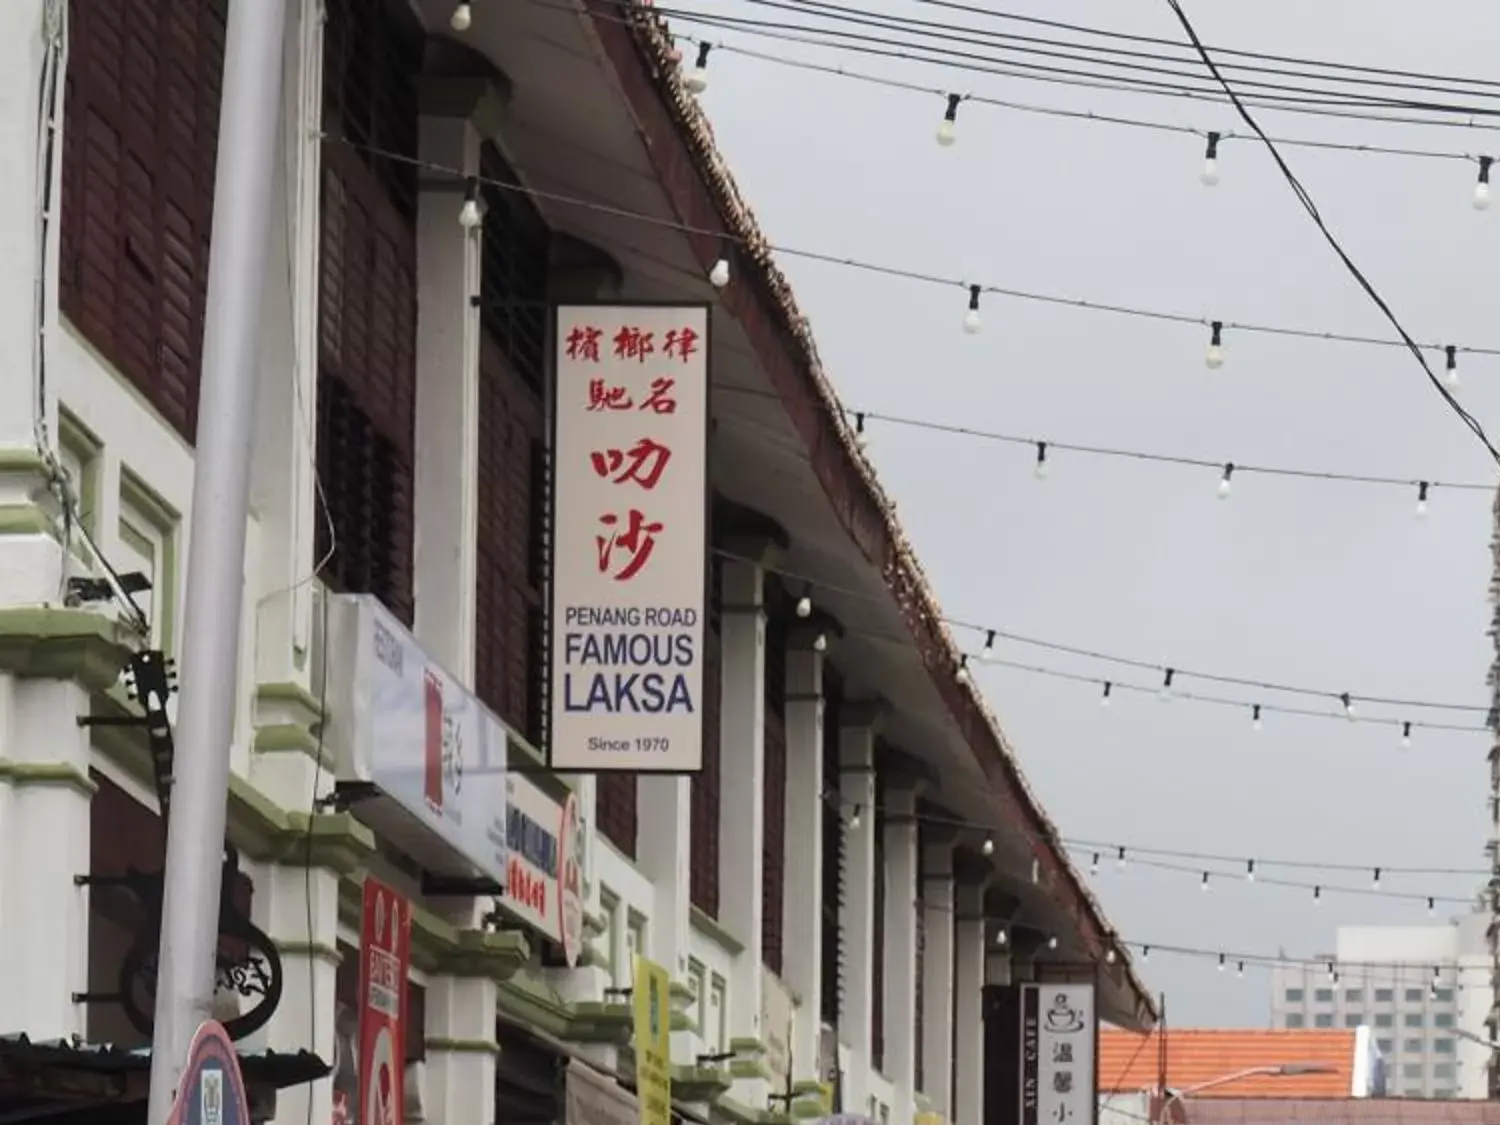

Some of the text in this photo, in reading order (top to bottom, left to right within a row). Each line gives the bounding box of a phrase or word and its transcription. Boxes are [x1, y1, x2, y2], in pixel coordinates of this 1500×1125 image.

[565, 607, 697, 627] PENANG ROAD
[565, 634, 693, 666] FAMOUS
[564, 673, 694, 713] LAKSA
[588, 738, 669, 752] Since 1970
